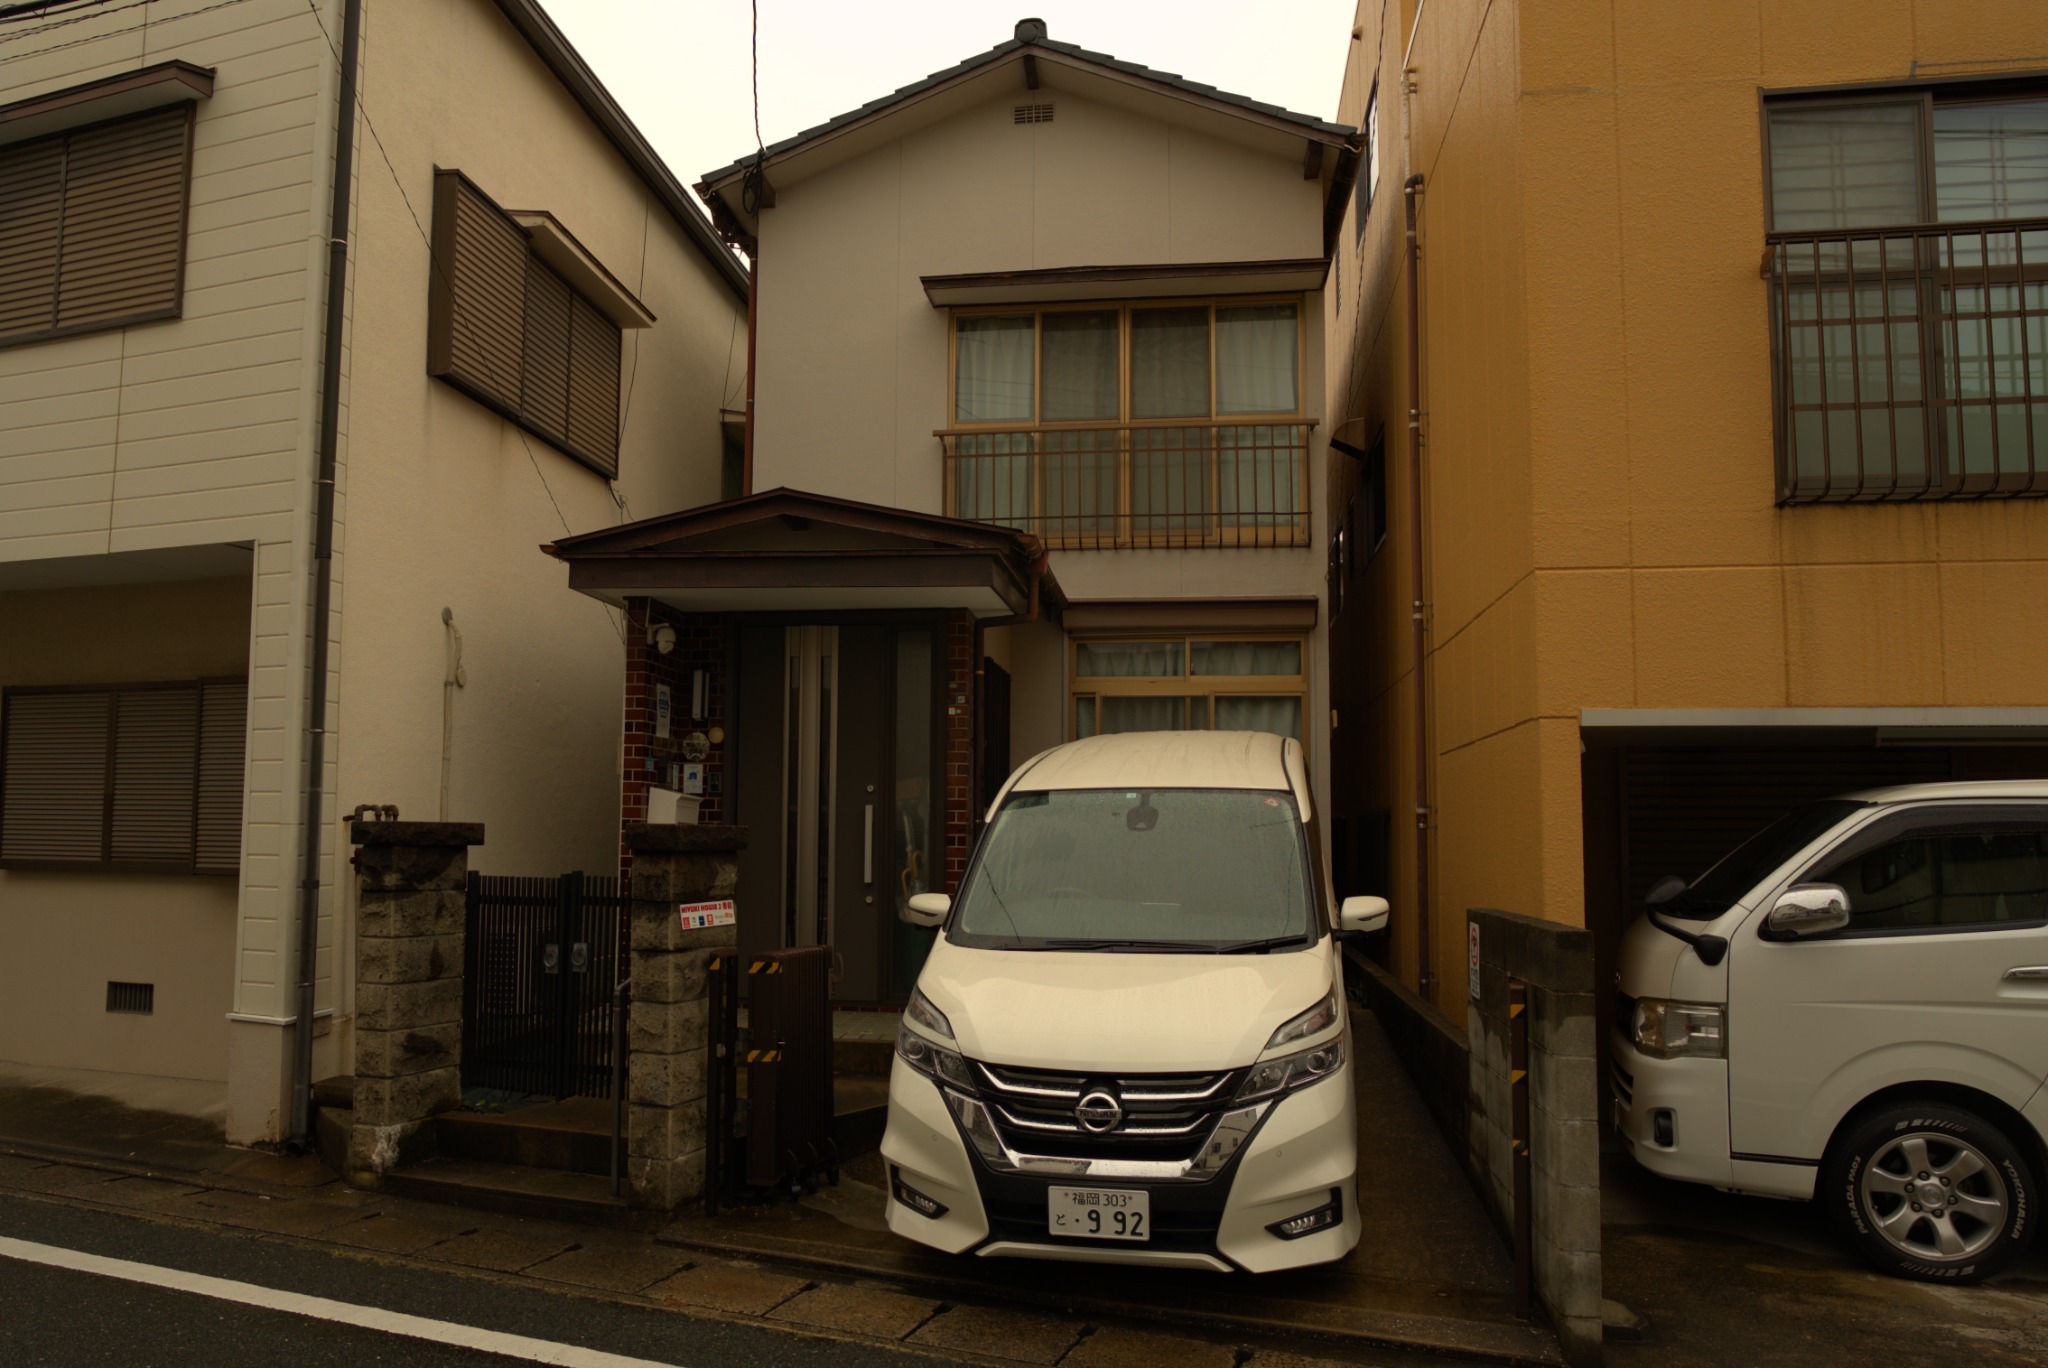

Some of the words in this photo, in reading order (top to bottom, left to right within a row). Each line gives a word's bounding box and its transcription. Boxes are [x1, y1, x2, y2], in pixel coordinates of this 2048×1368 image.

[701, 903, 717, 911] HOUSE
[1079, 1110, 1117, 1118] NISSAN
[1072, 1192, 1100, 1206] 福岡
[1103, 1193, 1127, 1207] 303
[2002, 1159, 2027, 1240] YOKOHAMA
[1845, 1184, 1869, 1235] PARADA
